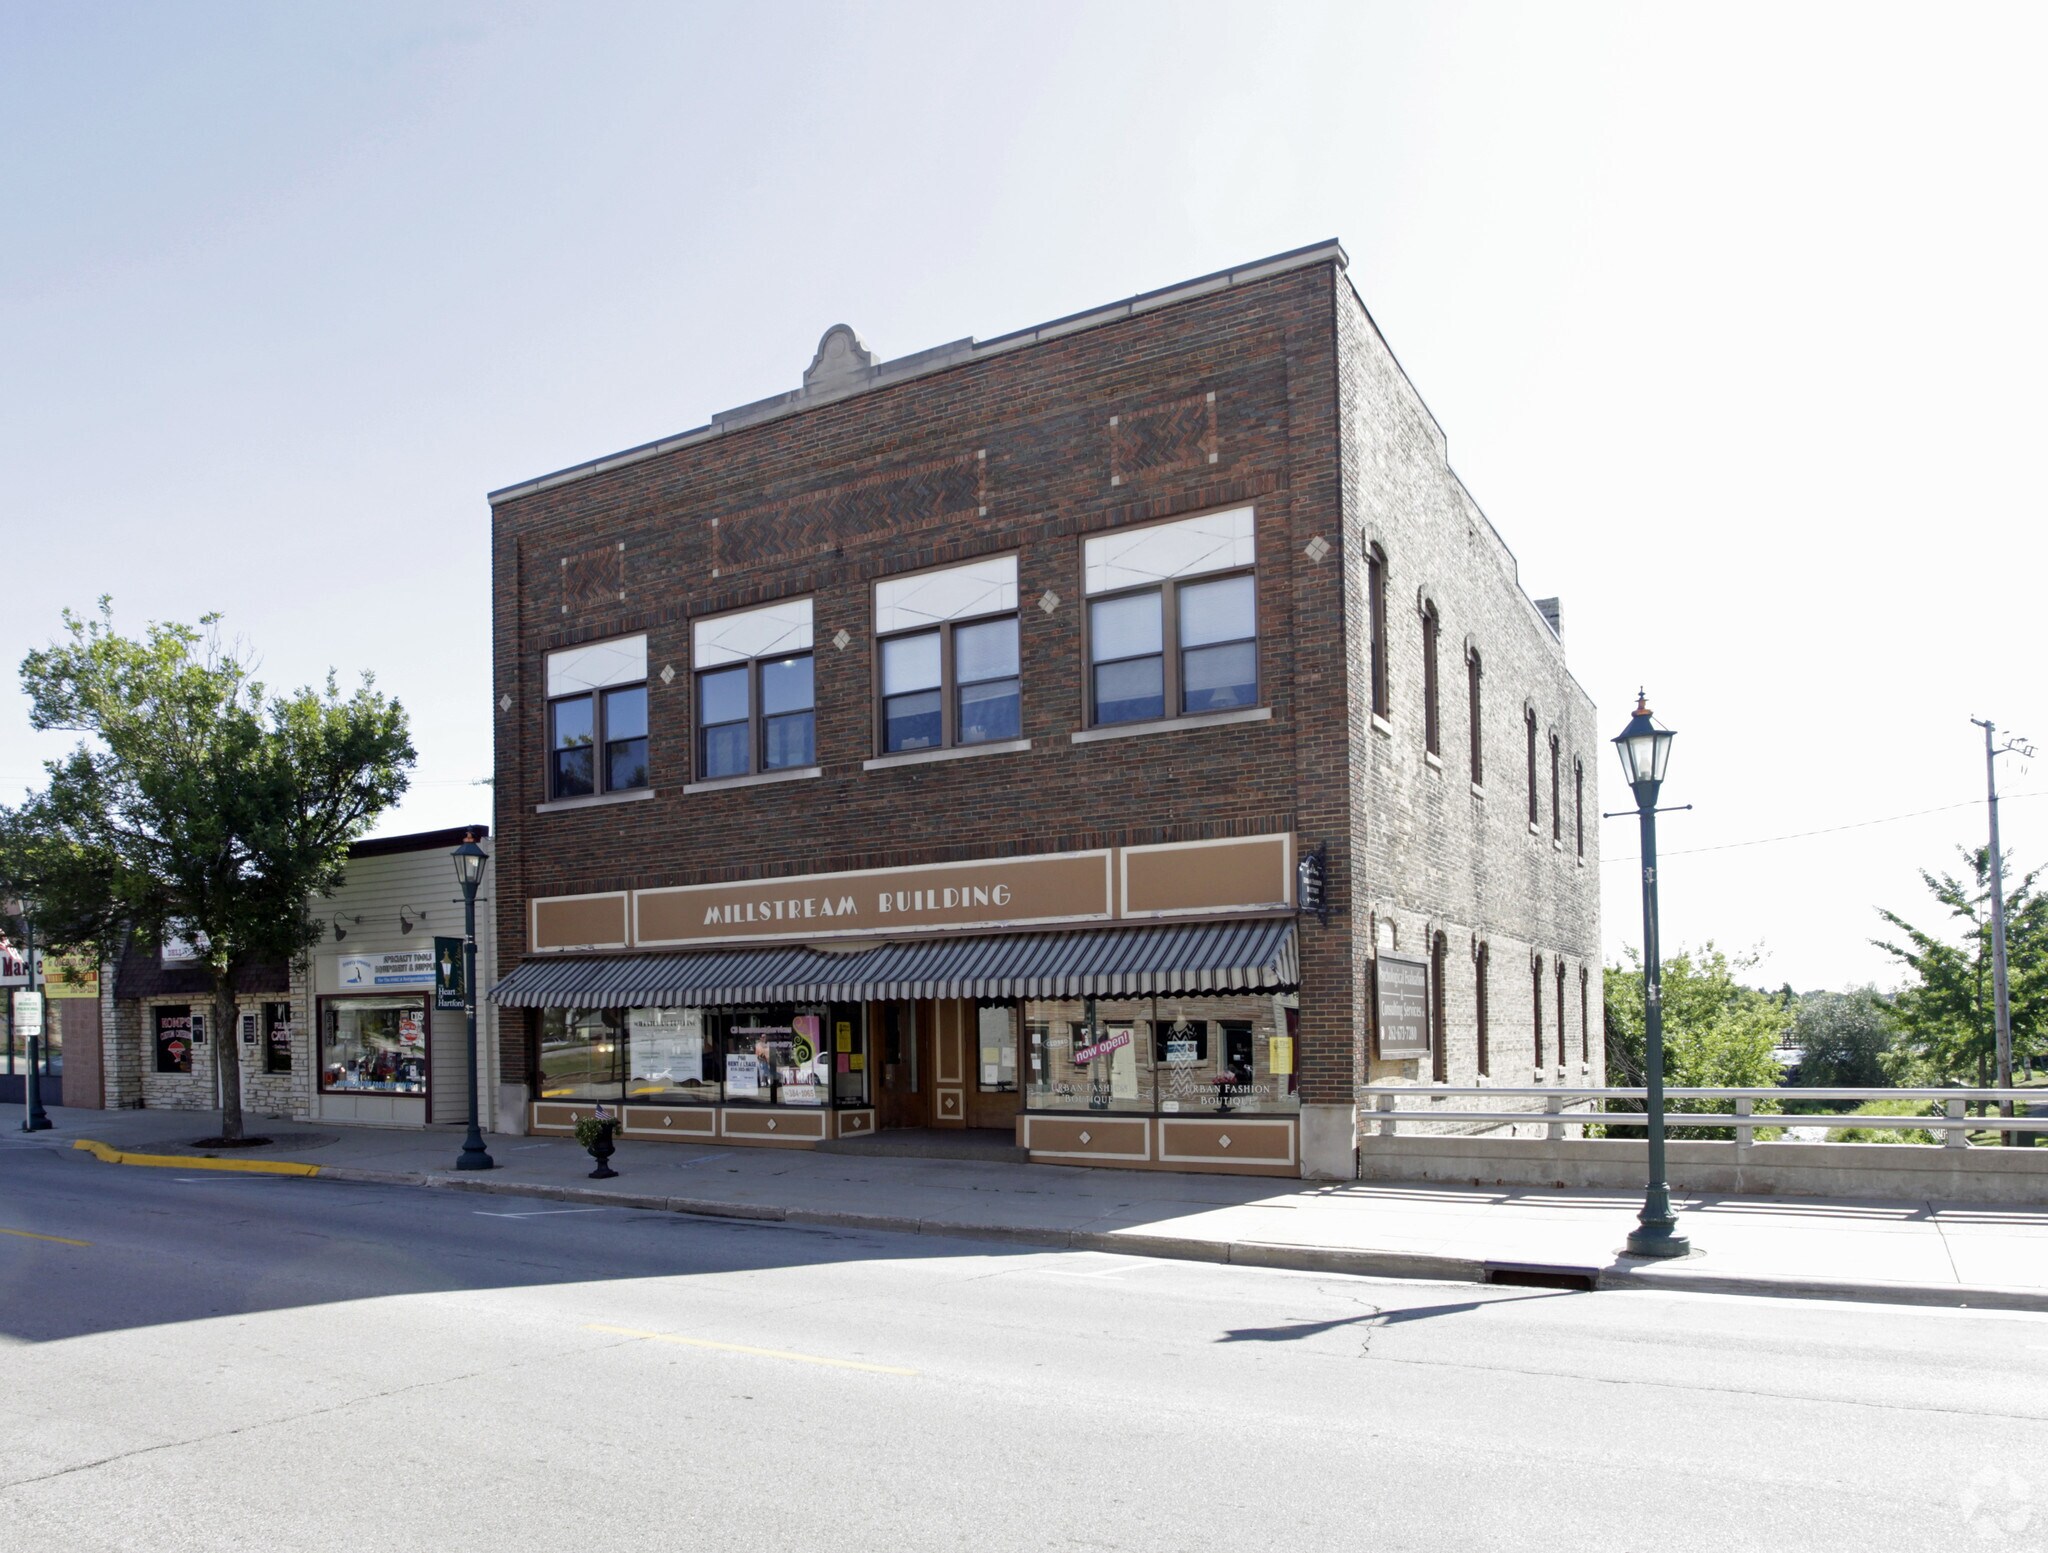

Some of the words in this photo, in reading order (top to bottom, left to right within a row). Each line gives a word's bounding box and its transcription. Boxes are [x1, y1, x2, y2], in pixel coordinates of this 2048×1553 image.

[703, 896, 858, 925] MILLSTREAM
[879, 884, 1011, 913] BUILDING
[383, 955, 412, 963] SPECIALTY
[414, 953, 432, 961] TOOLS
[3, 957, 43, 977] Mare
[375, 964, 408, 973] EQUIPMENT
[409, 963, 414, 971] &
[438, 987, 456, 995] Heart
[438, 999, 465, 1007] Hartford
[1381, 1000, 1404, 1020] Consulting
[1404, 1002, 1421, 1016] Services
[1076, 1046, 1097, 1062] now
[1099, 1030, 1129, 1054] open!
[1052, 1083, 1083, 1093] URBAN
[1186, 1084, 1220, 1094] URBAN
[1224, 1083, 1270, 1094] FASHION
[1065, 1094, 1113, 1104] BOUTIQUE
[1201, 1096, 1253, 1105] BOUTIQUE
